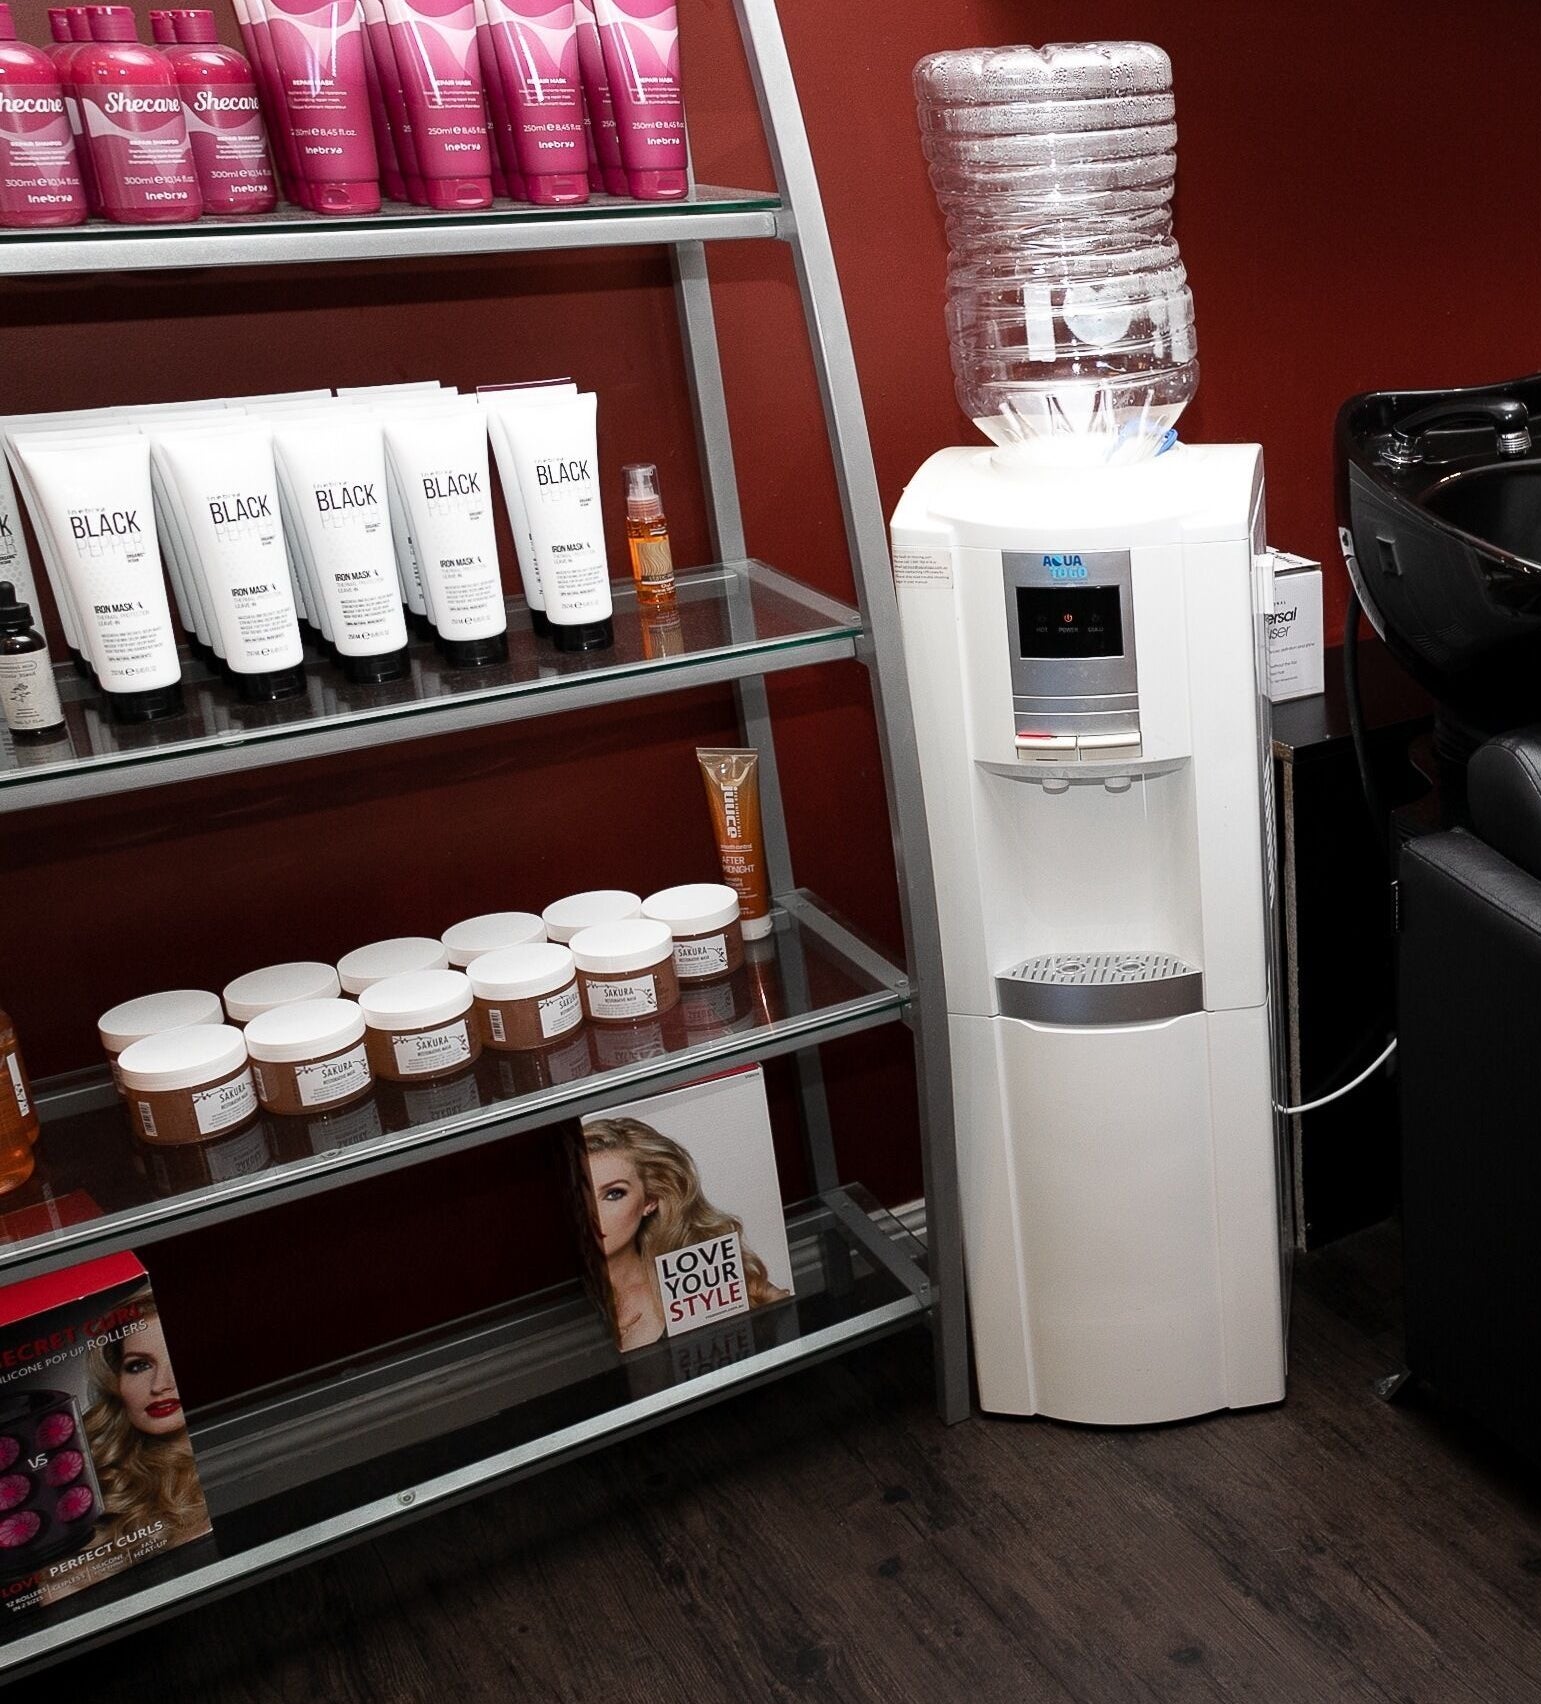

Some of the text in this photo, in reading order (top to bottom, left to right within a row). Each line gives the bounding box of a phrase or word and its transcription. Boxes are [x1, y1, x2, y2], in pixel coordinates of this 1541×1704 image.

[0, 91, 63, 113] hecare
[104, 91, 180, 114] Shecare
[193, 90, 260, 111] Shecare
[320, 128, 337, 137] 8,45
[5, 179, 36, 187] 300ml
[124, 176, 153, 185] 300ml
[211, 170, 238, 178] 300ml
[536, 459, 591, 487] BLACK
[422, 472, 481, 500] BLACK
[315, 483, 378, 512] BLACK
[208, 494, 272, 525] BLACK
[69, 510, 141, 539] BLACK
[439, 556, 474, 568] IRON MASK
[1042, 555, 1083, 567] AQUA
[334, 569, 371, 583] IRON MASK
[231, 584, 269, 597] IRON MASK
[94, 601, 134, 615] IRON MASK
[721, 782, 738, 839] juuce
[722, 856, 745, 865] AFTER
[677, 946, 708, 957] SAKURA
[603, 987, 635, 998] SAKURA
[416, 1035, 449, 1051] SAKURA
[321, 1060, 354, 1079] SAKURA
[219, 1082, 248, 1103] SAKURA
[661, 1238, 736, 1280] LOVE
[664, 1261, 739, 1300] YOUR
[669, 1281, 742, 1323] STYLE
[0, 1327, 77, 1369] ECRET
[45, 1352, 68, 1367] POP
[69, 1346, 85, 1358] UP
[86, 1318, 148, 1352] ROLLERS
[49, 1541, 114, 1577] PERFECT
[116, 1520, 164, 1548] CURLS
